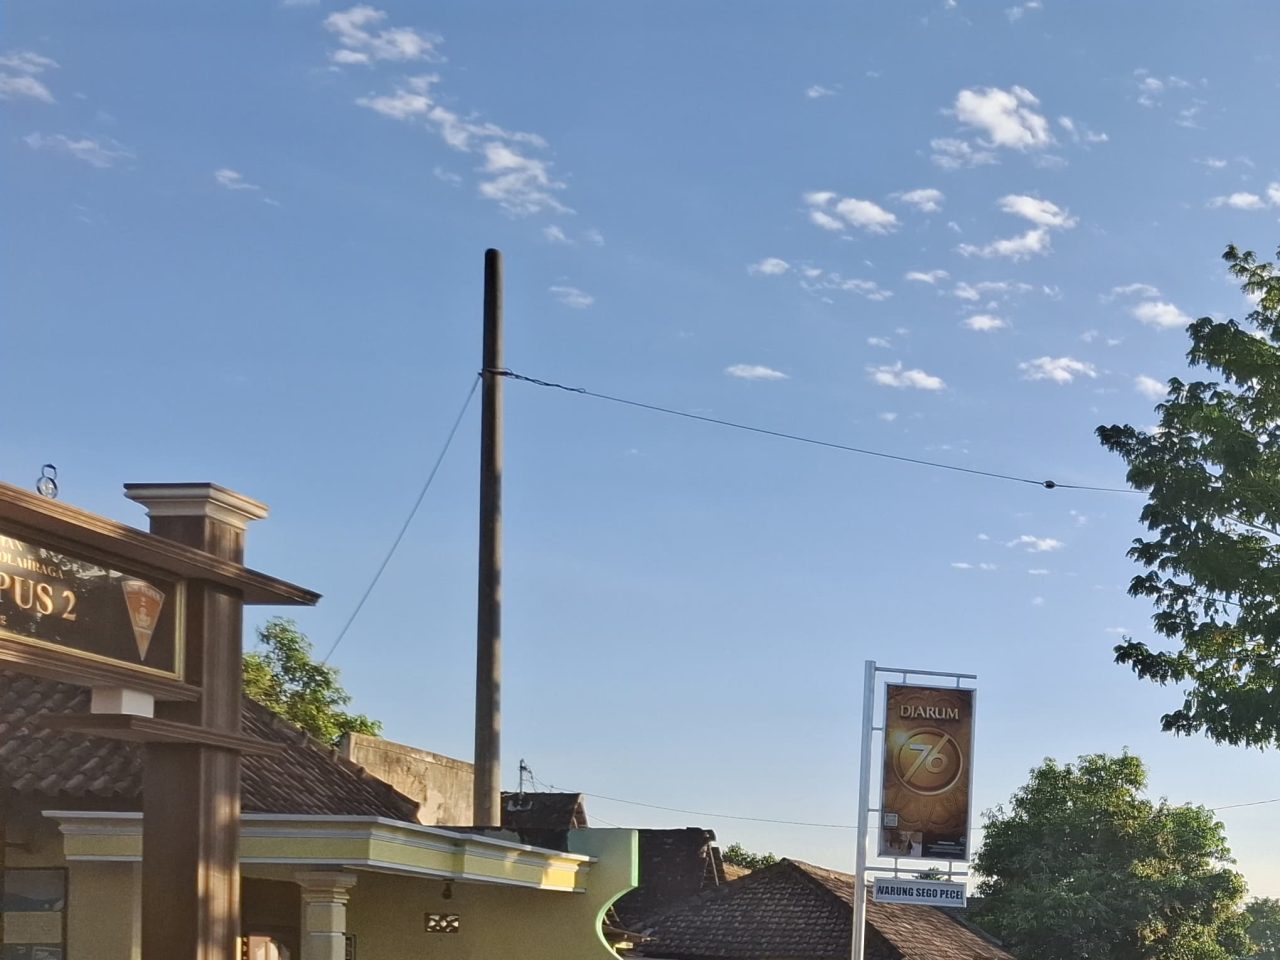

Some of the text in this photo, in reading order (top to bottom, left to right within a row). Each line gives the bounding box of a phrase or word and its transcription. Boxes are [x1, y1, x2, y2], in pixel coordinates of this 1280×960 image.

[61, 590, 77, 622] 2
[900, 704, 959, 720] DJARUM
[903, 734, 949, 782] 76
[915, 887, 938, 898] SEGO
